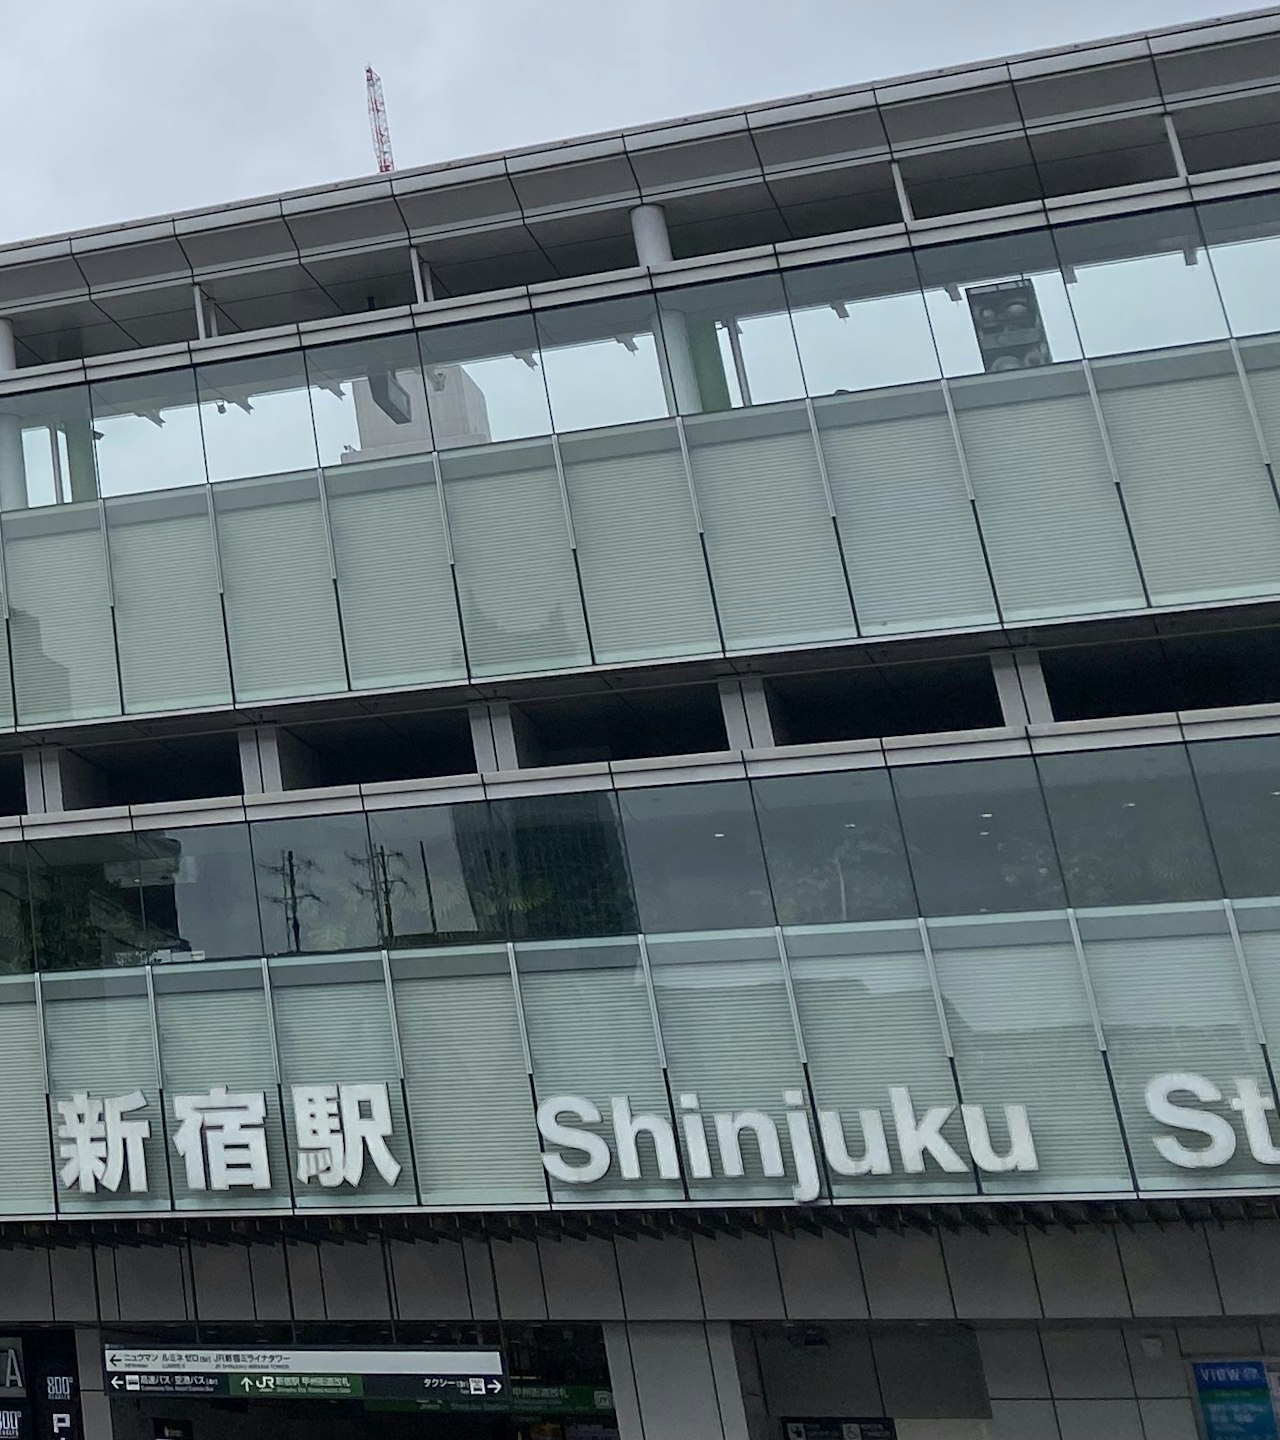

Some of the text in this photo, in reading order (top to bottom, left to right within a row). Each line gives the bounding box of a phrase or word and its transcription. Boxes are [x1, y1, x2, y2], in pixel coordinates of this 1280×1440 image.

[57, 1083, 403, 1193] 新宿駅
[536, 1086, 1039, 1203] Shinjuku
[255, 1376, 275, 1388] JR
[423, 1378, 456, 1388] タクシー
